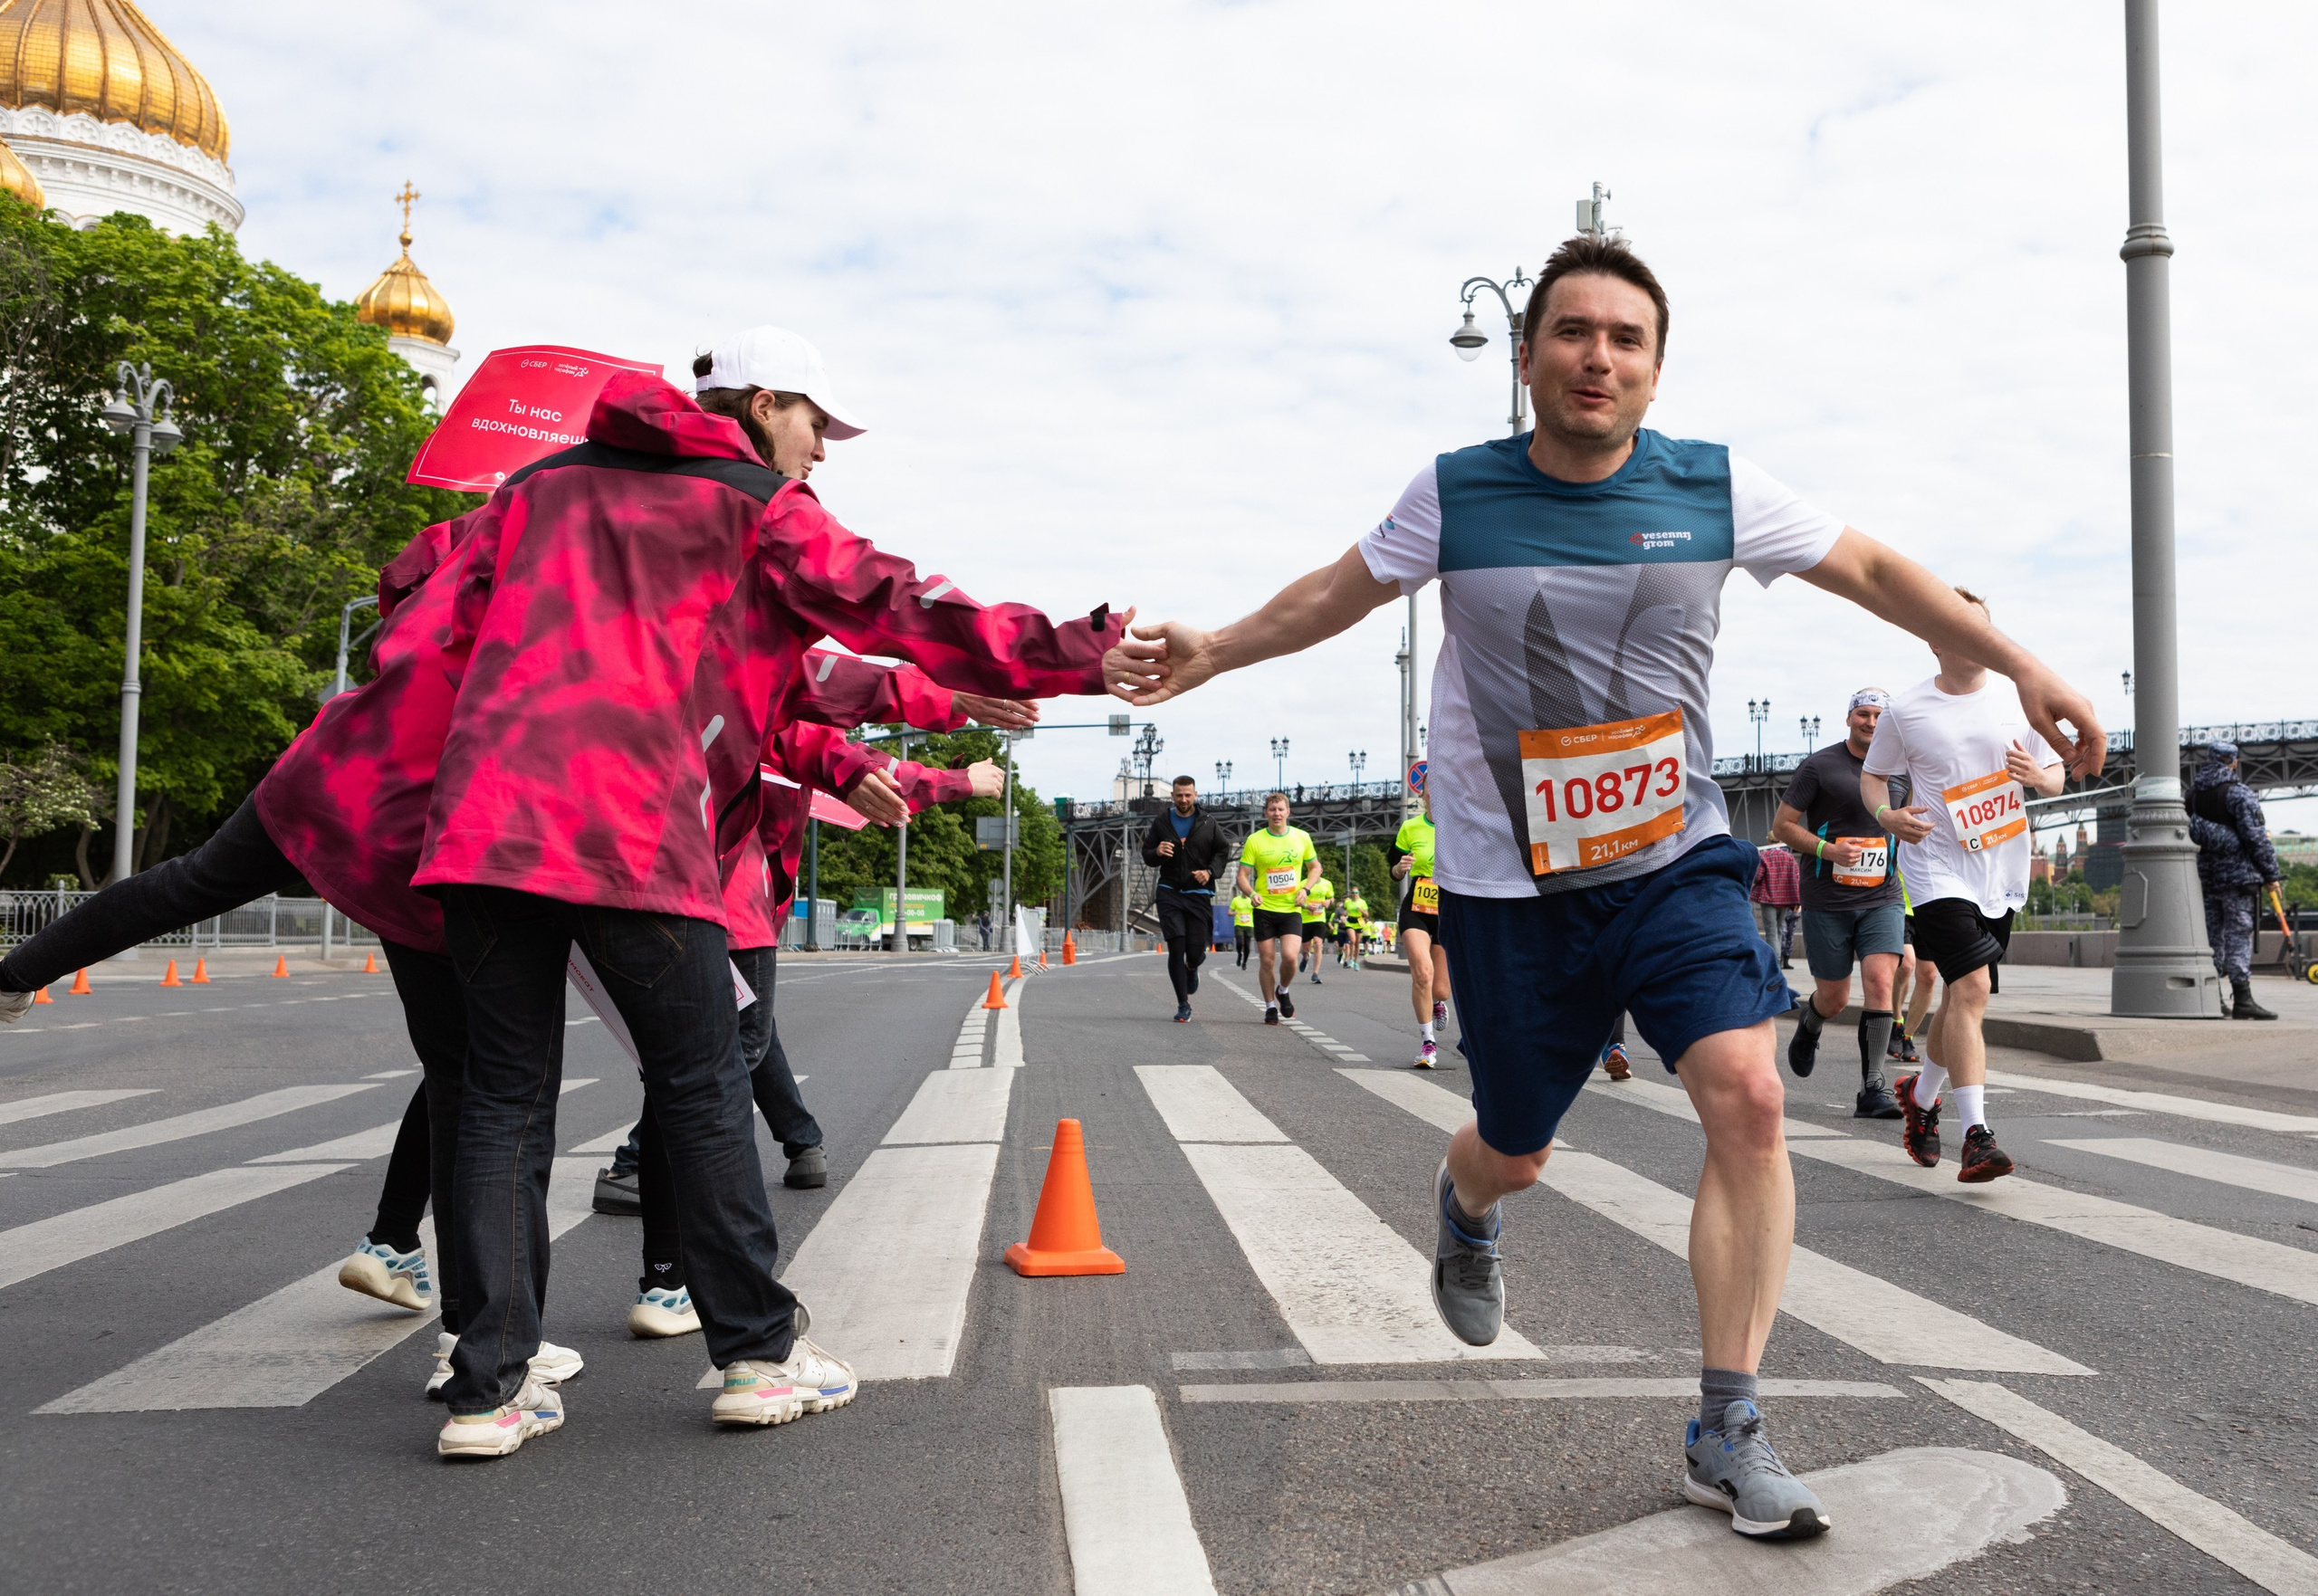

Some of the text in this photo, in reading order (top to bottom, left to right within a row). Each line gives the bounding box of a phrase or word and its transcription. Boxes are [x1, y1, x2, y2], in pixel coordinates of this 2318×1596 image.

[529, 360, 548, 368] СБЕР
[508, 398, 562, 422] Ты нас
[471, 417, 589, 444] вдохновляеш
[1643, 540, 1674, 550] grom
[1573, 734, 1598, 744] СБЕР
[1535, 757, 1681, 823] 10873
[1956, 790, 2021, 830] 10874
[1268, 873, 1295, 884] 10504
[888, 893, 943, 903] грзовичкоф
[1417, 885, 1438, 900] 102
